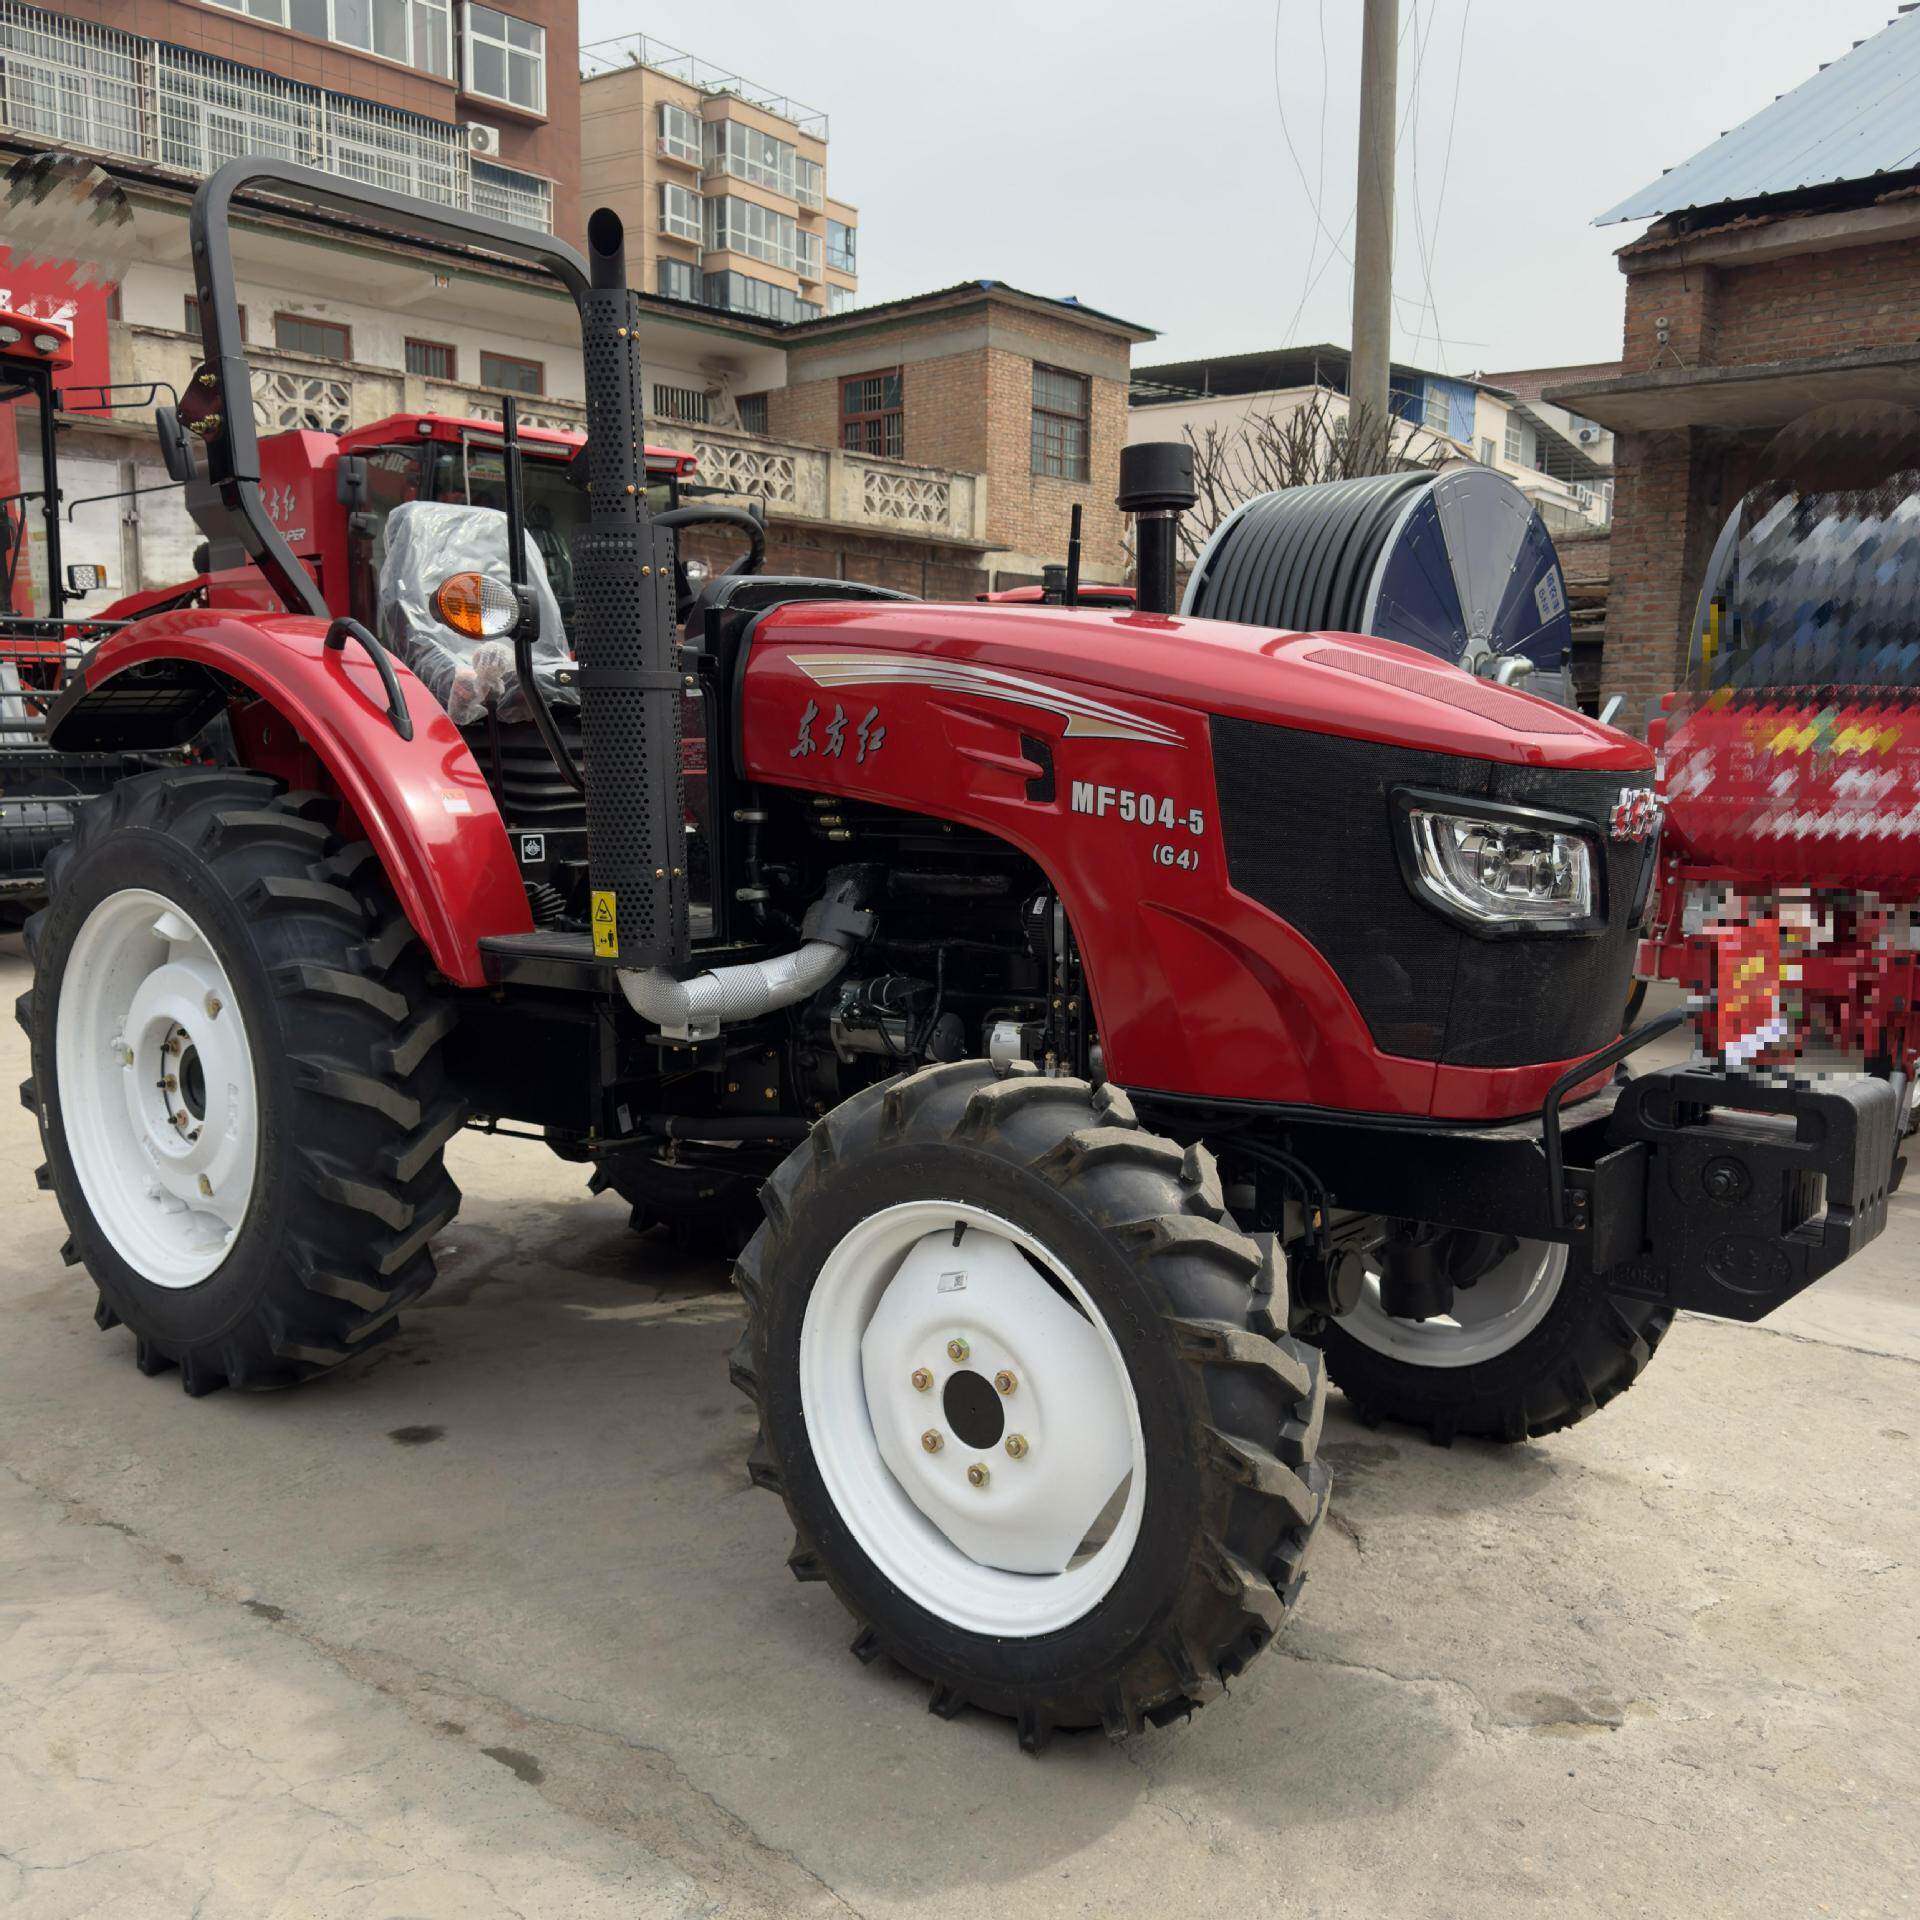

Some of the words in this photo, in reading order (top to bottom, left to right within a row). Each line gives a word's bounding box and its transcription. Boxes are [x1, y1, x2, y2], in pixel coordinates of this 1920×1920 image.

[790, 698, 886, 764] 东方红
[1071, 779, 1204, 836] MF504-5
[1152, 842, 1199, 872] (G4)
